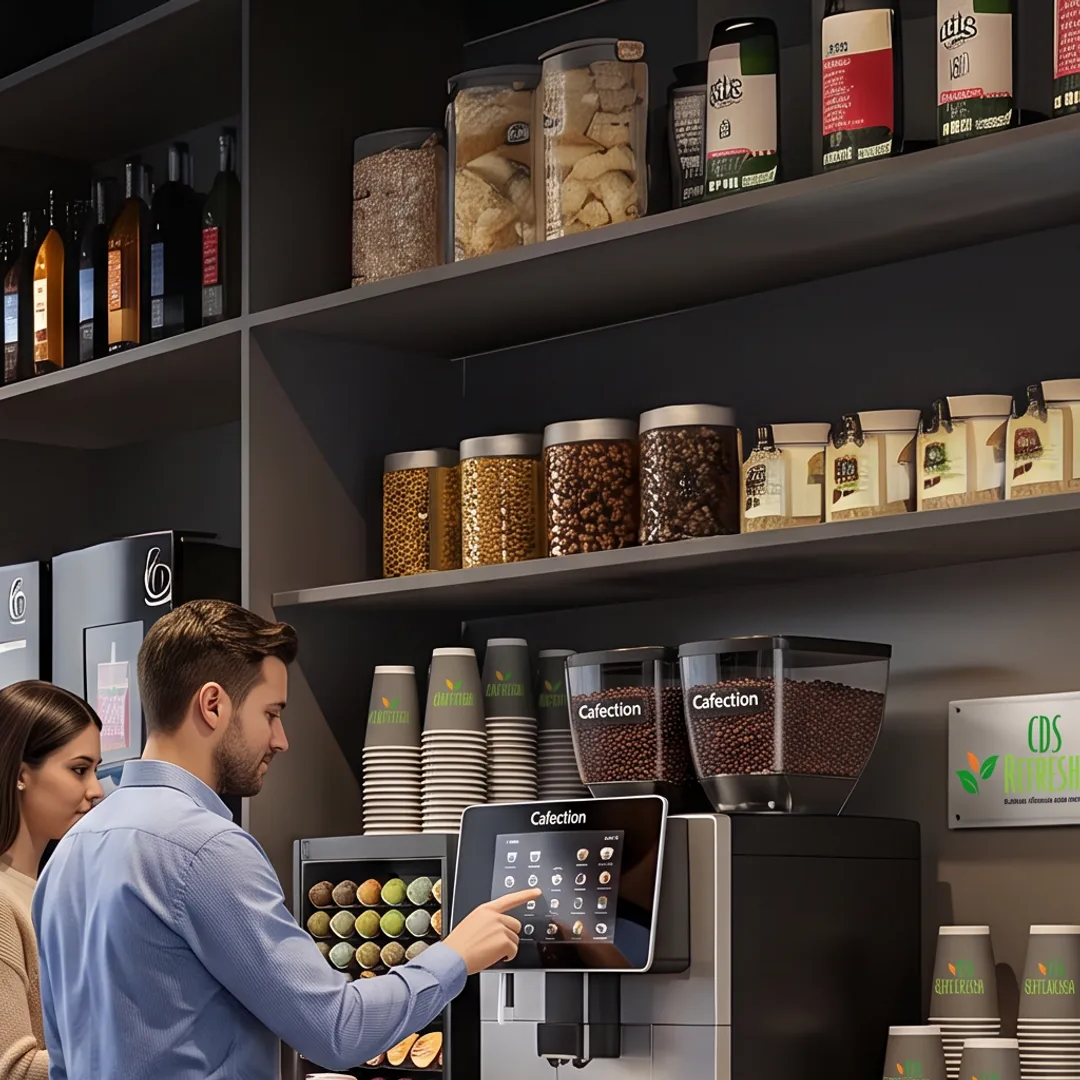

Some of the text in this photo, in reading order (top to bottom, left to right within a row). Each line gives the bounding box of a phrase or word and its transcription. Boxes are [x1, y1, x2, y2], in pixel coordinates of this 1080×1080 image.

[692, 692, 759, 710] Cafection
[578, 702, 642, 720] Cafection
[1027, 714, 1062, 753] CDS
[531, 810, 587, 826] Cafection
